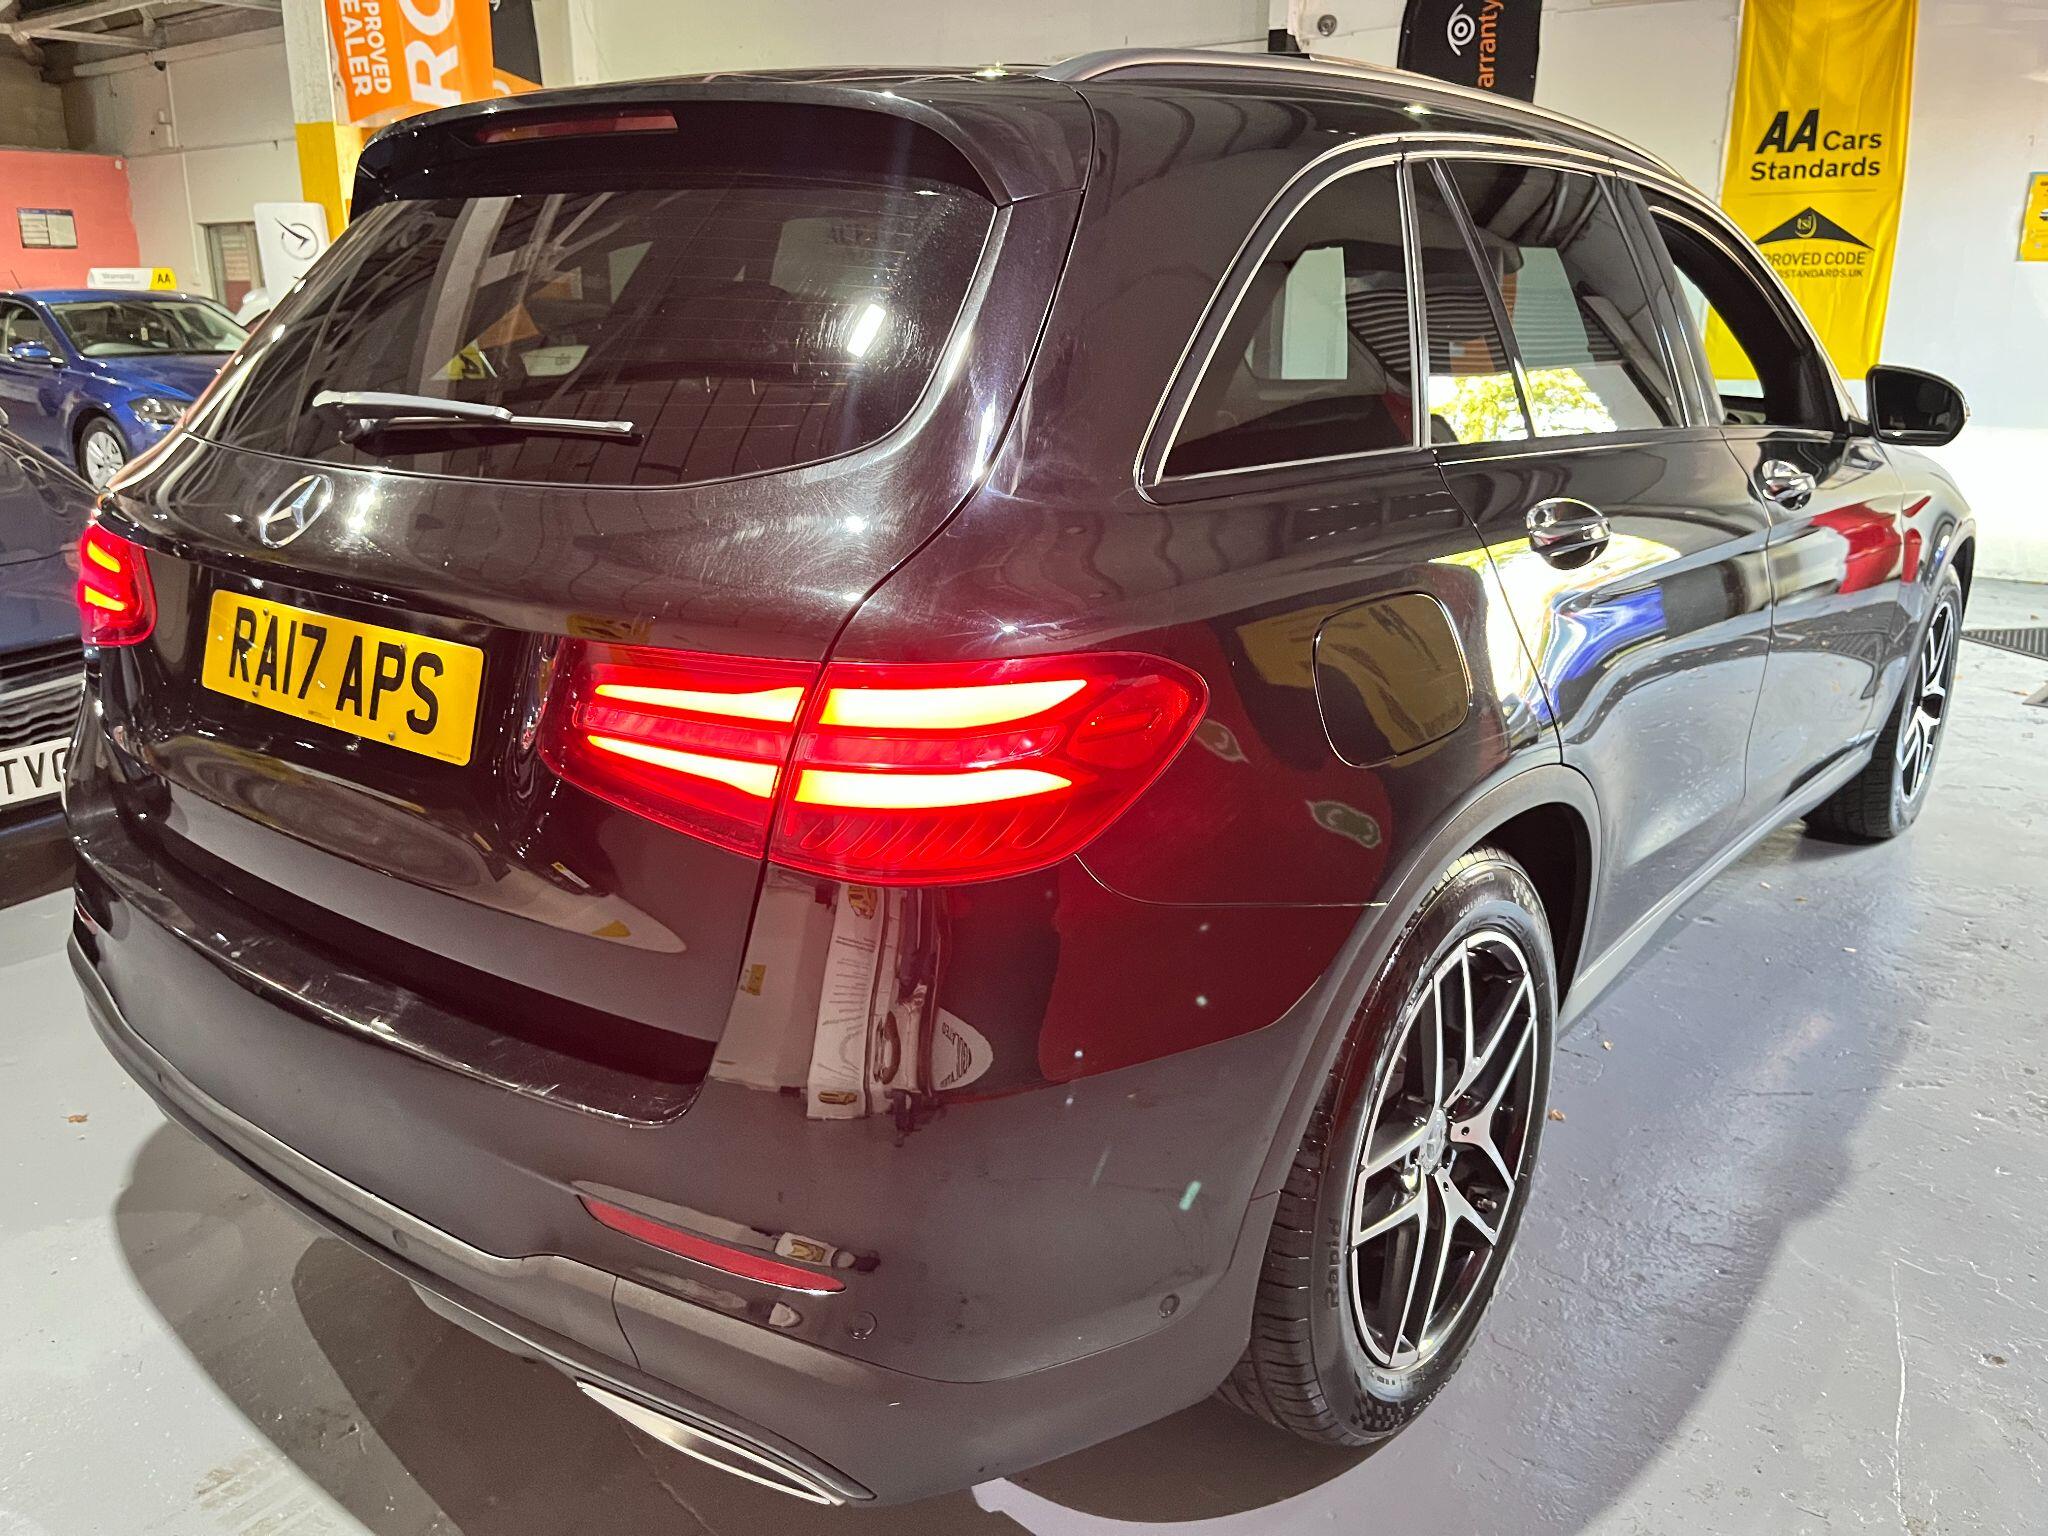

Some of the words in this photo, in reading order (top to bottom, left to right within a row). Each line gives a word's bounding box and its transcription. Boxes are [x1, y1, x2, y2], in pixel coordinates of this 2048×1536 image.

[361, 2, 392, 94] PROVED
[1755, 109, 1820, 154] AA
[1823, 130, 1882, 151] Cars
[1750, 157, 1880, 181] Standards
[1824, 251, 1867, 265] CODE
[157, 273, 171, 284] AA
[229, 606, 327, 700] RA17
[335, 635, 444, 735] APS
